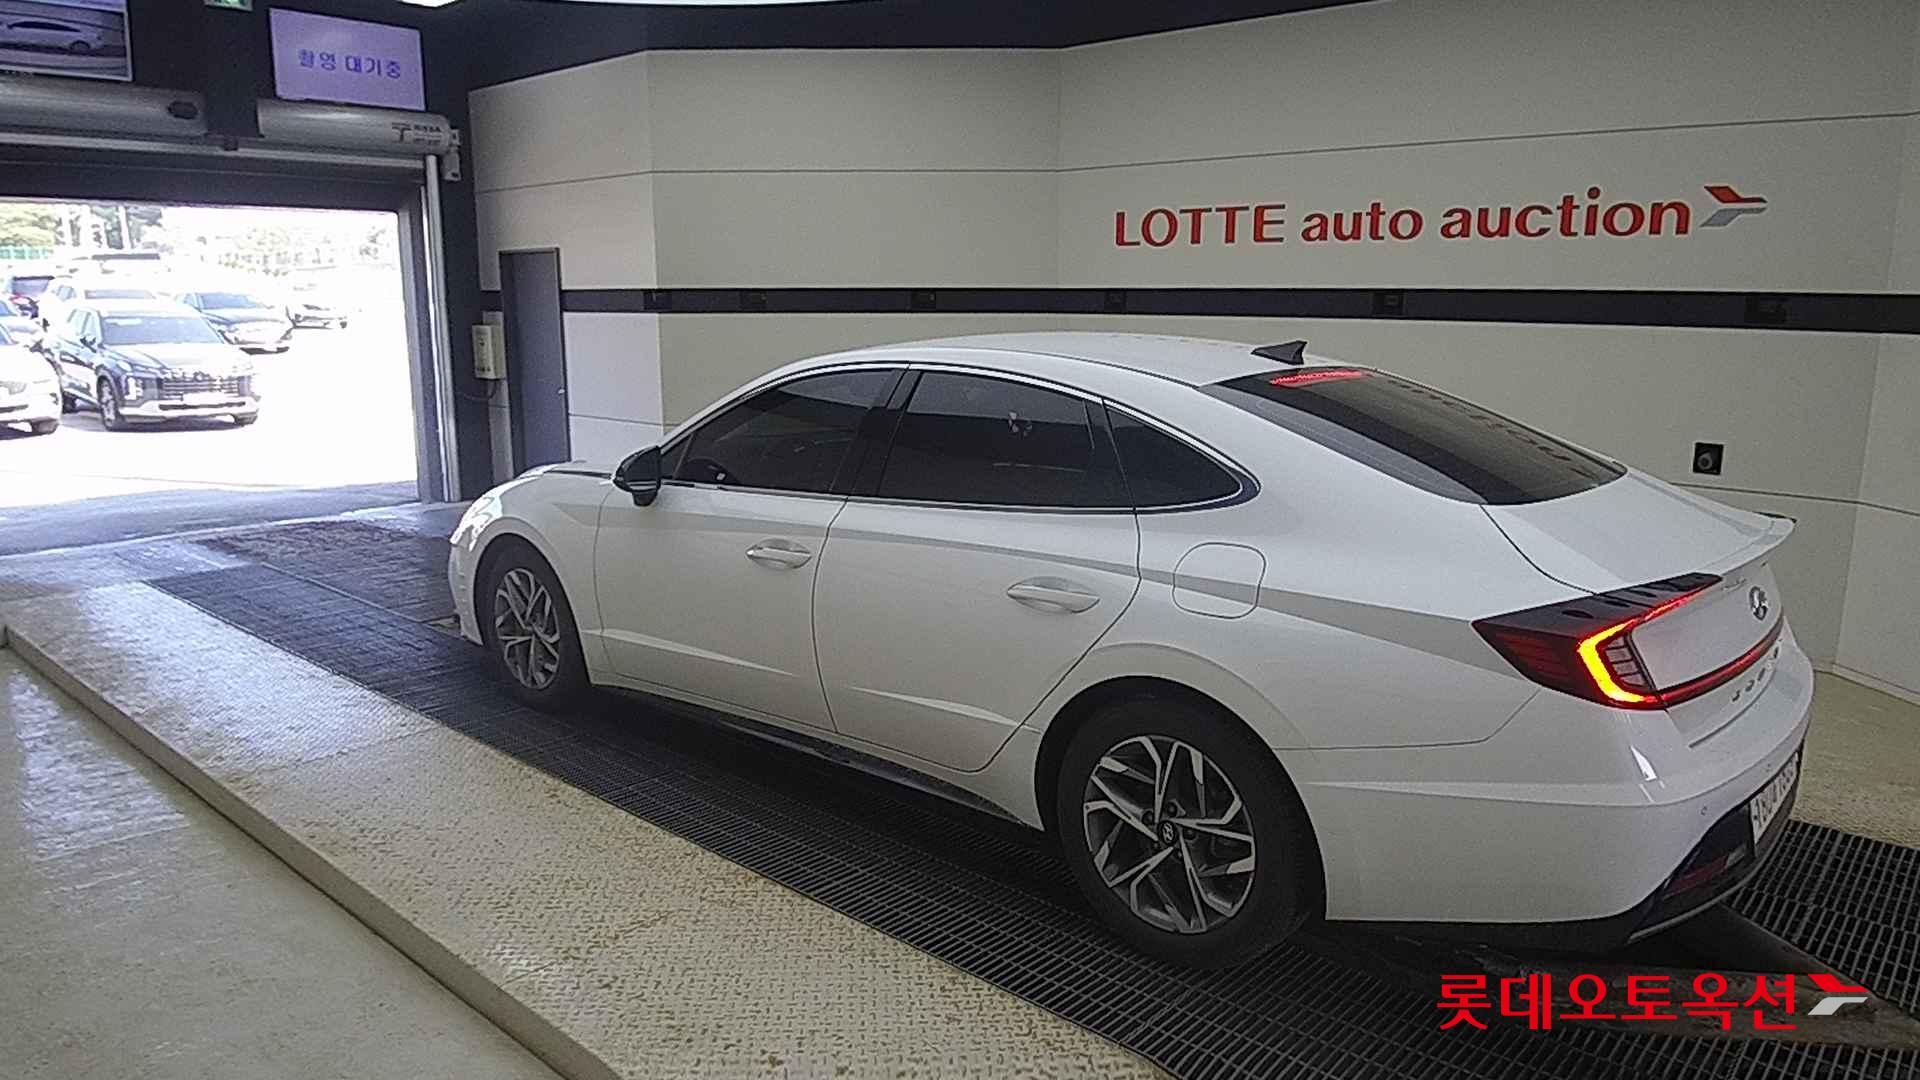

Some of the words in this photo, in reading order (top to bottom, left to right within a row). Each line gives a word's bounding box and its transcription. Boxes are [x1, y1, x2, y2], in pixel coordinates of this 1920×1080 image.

[344, 55, 402, 80] 대기중
[1115, 203, 1286, 248] LOTTE
[1302, 202, 1425, 242] auto
[1439, 187, 1692, 240] auction
